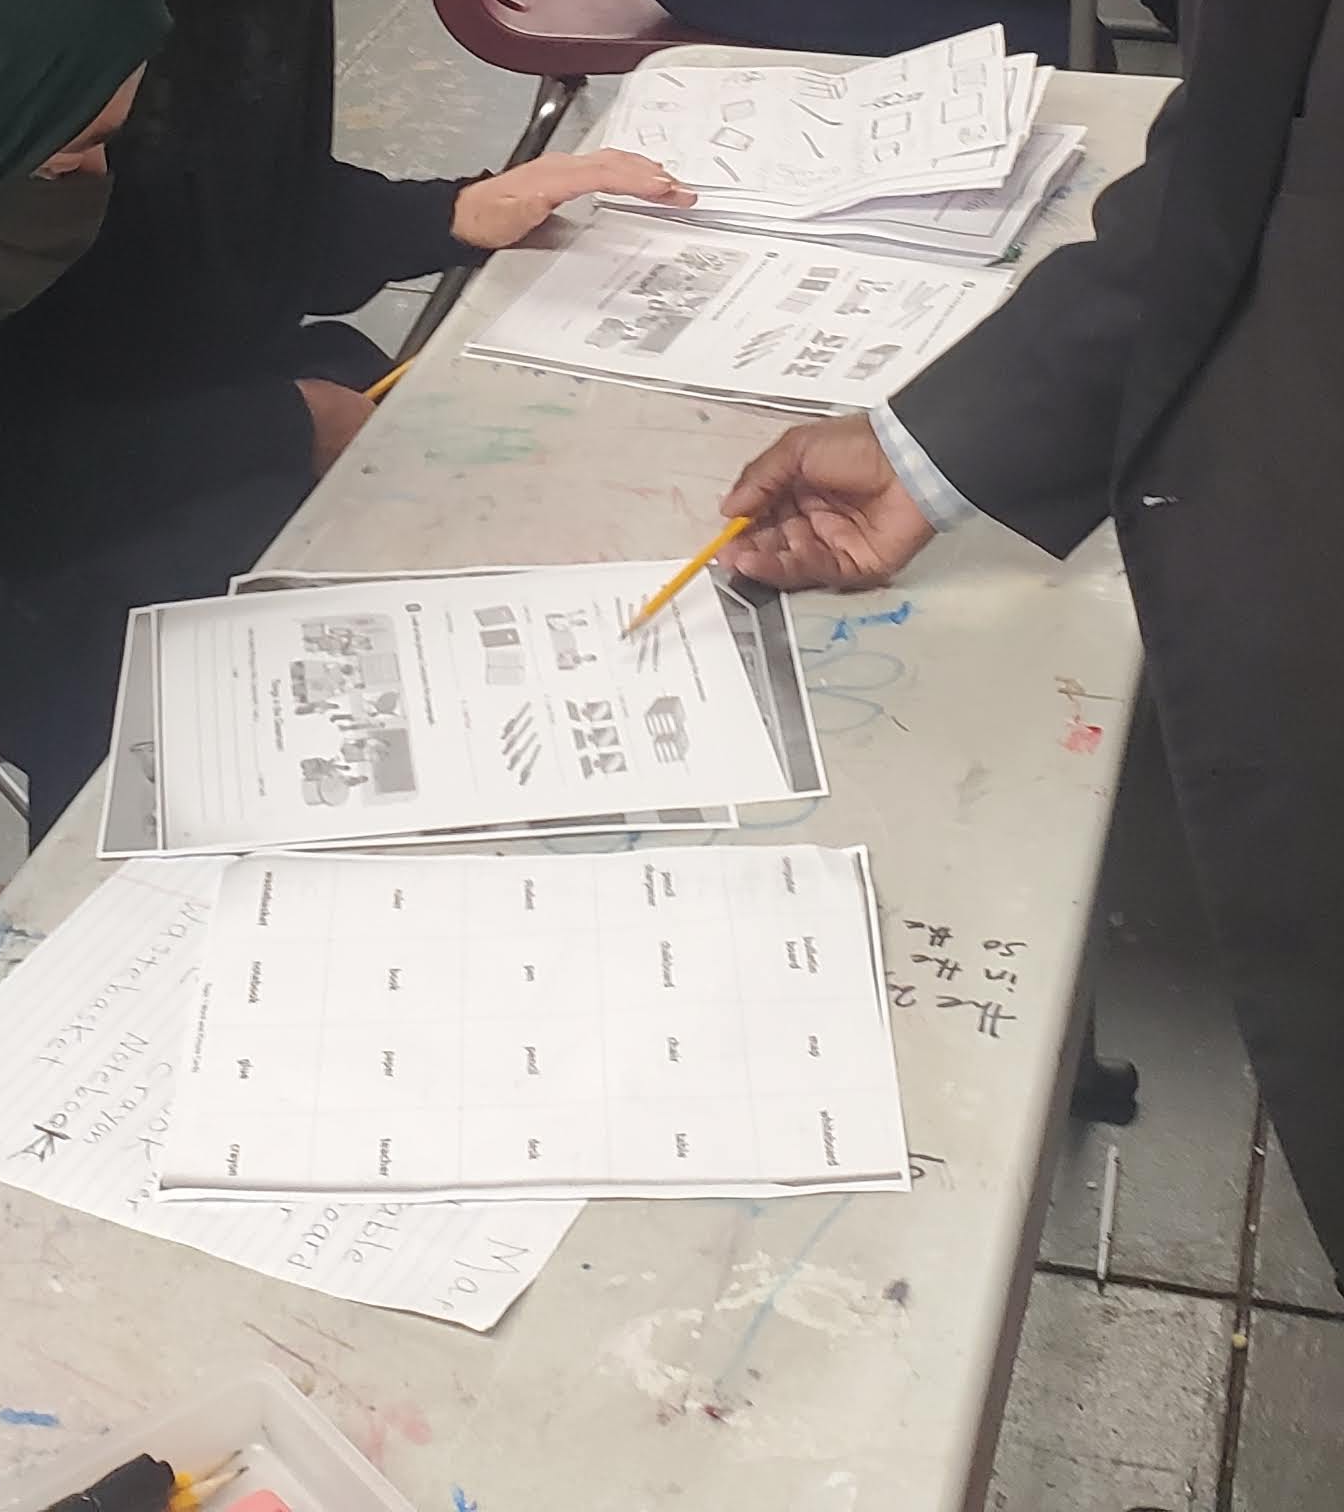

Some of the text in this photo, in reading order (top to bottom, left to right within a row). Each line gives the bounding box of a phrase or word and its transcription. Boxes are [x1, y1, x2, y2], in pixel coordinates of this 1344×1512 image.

[257, 870, 272, 927] wastebasket
[660, 871, 676, 898] pencil
[785, 940, 802, 969] board
[802, 935, 819, 974] bulletin
[247, 960, 262, 1004] notebook
[388, 968, 402, 992] book
[522, 964, 536, 982] pen
[666, 1036, 681, 1063] chair
[807, 1035, 821, 1058] map
[236, 1058, 253, 1080] glue
[381, 1050, 396, 1078] paper
[523, 1046, 539, 1076] pencil
[527, 1138, 541, 1161] desk
[674, 1132, 689, 1159] table
[820, 1109, 840, 1167] whiteboard
[226, 1143, 241, 1177] crayon
[378, 1137, 393, 1177] teacher
